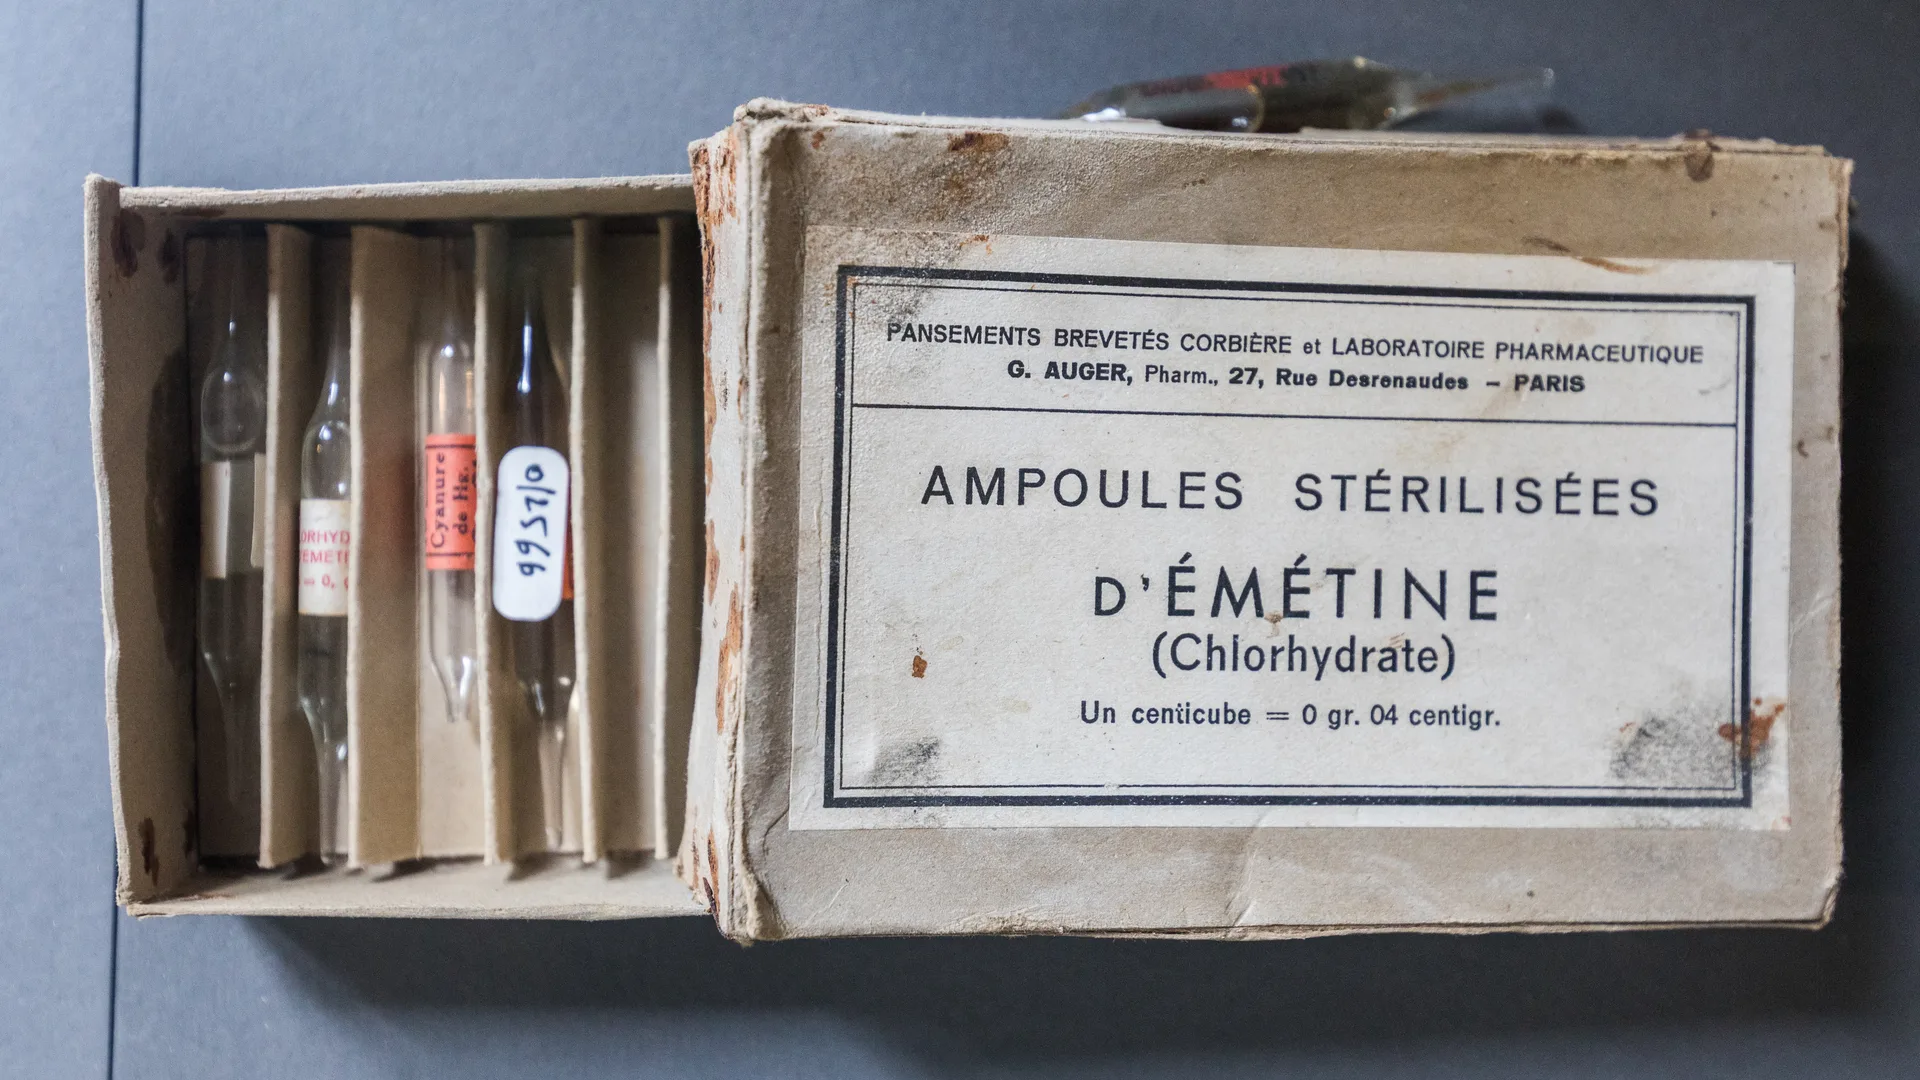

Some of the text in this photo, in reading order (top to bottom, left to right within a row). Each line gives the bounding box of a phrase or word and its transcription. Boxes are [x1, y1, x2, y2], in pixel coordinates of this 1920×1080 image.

[886, 322, 1703, 366] PANSEMENTS BREVETÉS CORBIÈRE et LABORATOIRE PHARMACEUTIQUE
[1007, 359, 1031, 379] G.
[1044, 360, 1133, 386] AUGER,
[1144, 364, 1220, 387] Pharm.,
[1228, 366, 1265, 389] 27,
[1275, 367, 1319, 387] Rue
[1327, 369, 1470, 391] Desrenaudes
[1512, 372, 1587, 394] PARIS
[430, 452, 448, 548] Cyanure
[920, 465, 1659, 517] AMPOULES STÉRILISÉES
[452, 511, 468, 535] de
[1152, 631, 1456, 682] (Chlorhydrate)
[1079, 700, 1116, 724] Un
[1130, 701, 1252, 725] centicube
[1326, 708, 1361, 731] gr.
[1369, 703, 1400, 726] 04
[1408, 702, 1501, 731] centigr.
